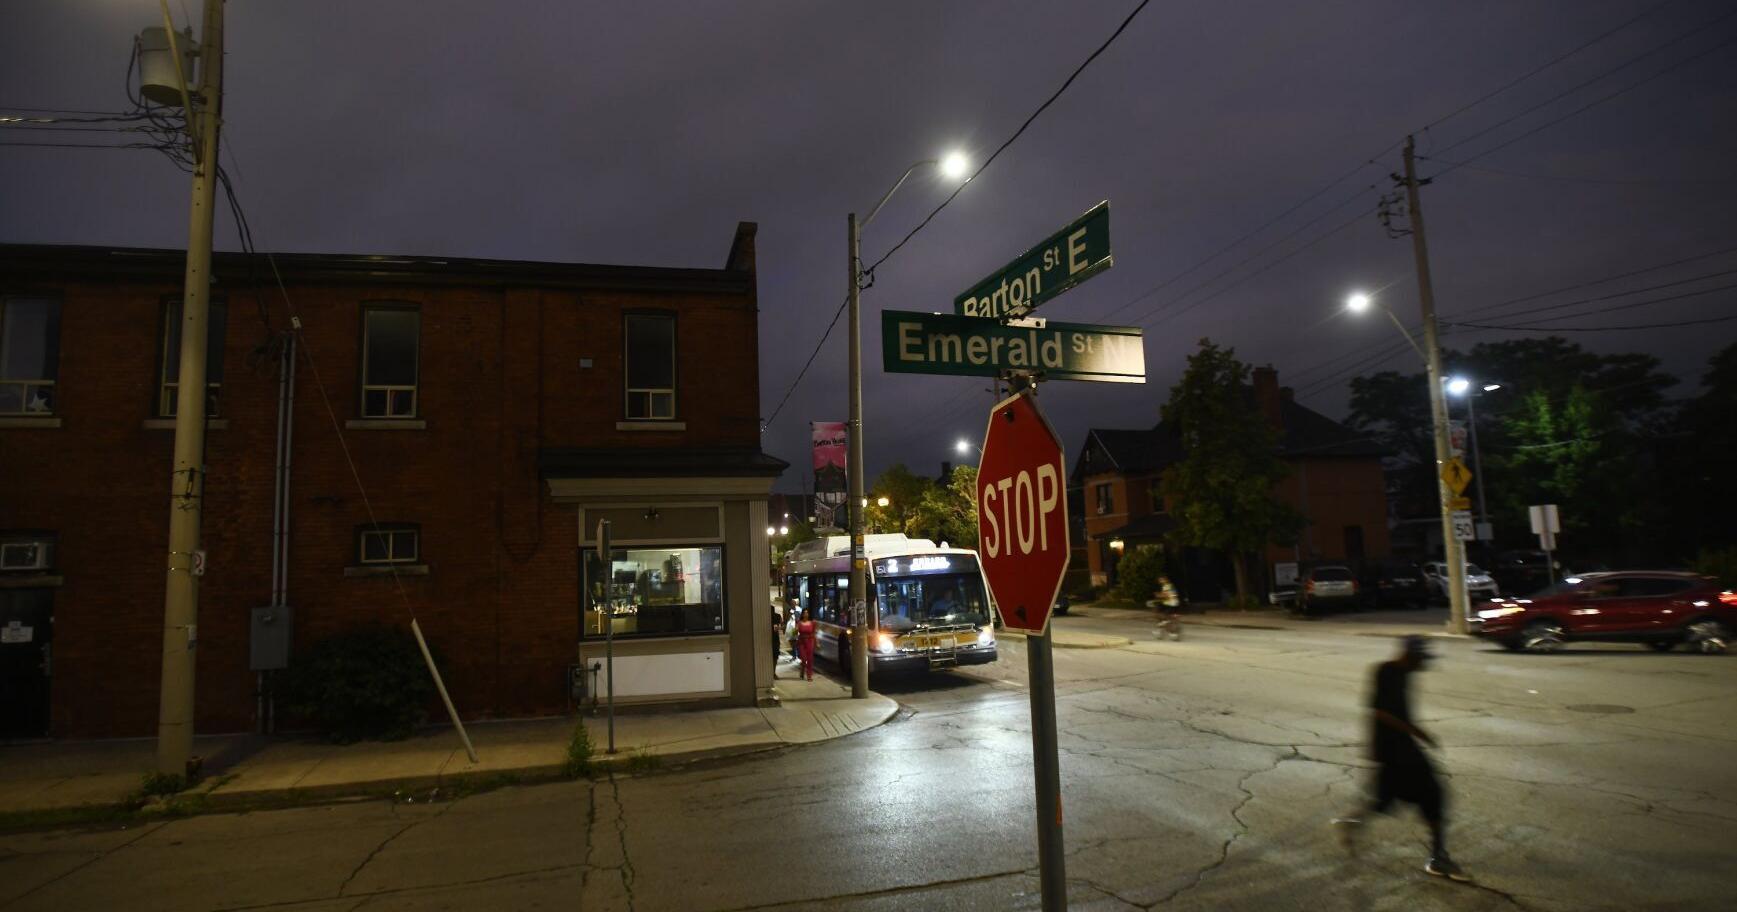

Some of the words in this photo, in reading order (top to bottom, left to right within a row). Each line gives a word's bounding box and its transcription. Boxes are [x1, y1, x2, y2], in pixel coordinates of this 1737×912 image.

[963, 267, 1041, 317] Barton
[1043, 248, 1060, 272] St
[1068, 227, 1088, 275] E
[899, 322, 1063, 368] Emerald
[1071, 333, 1094, 354] St
[983, 463, 1059, 559] STOP
[1455, 523, 1472, 537] 50
[887, 558, 899, 574] 2
